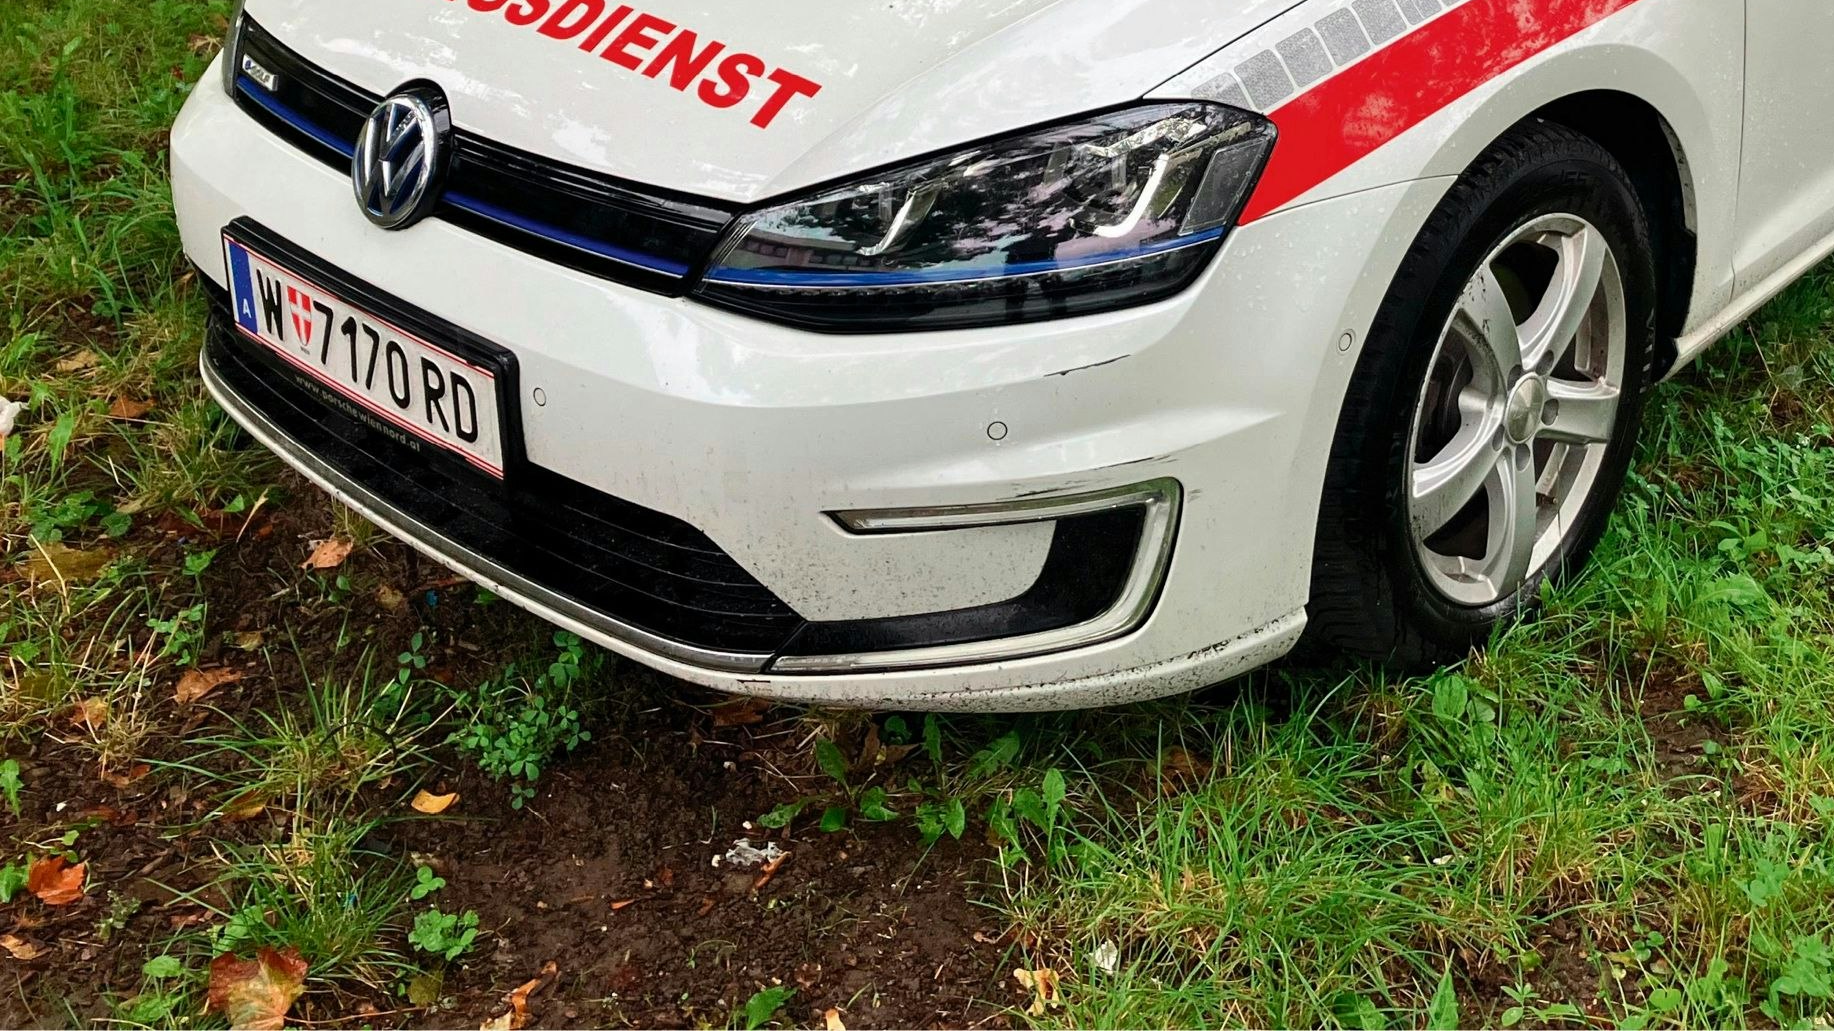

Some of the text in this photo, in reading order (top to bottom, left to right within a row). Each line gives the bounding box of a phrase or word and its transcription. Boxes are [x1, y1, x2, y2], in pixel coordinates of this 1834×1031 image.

[241, 298, 252, 319] A
[256, 268, 479, 444] W 7170 RD
